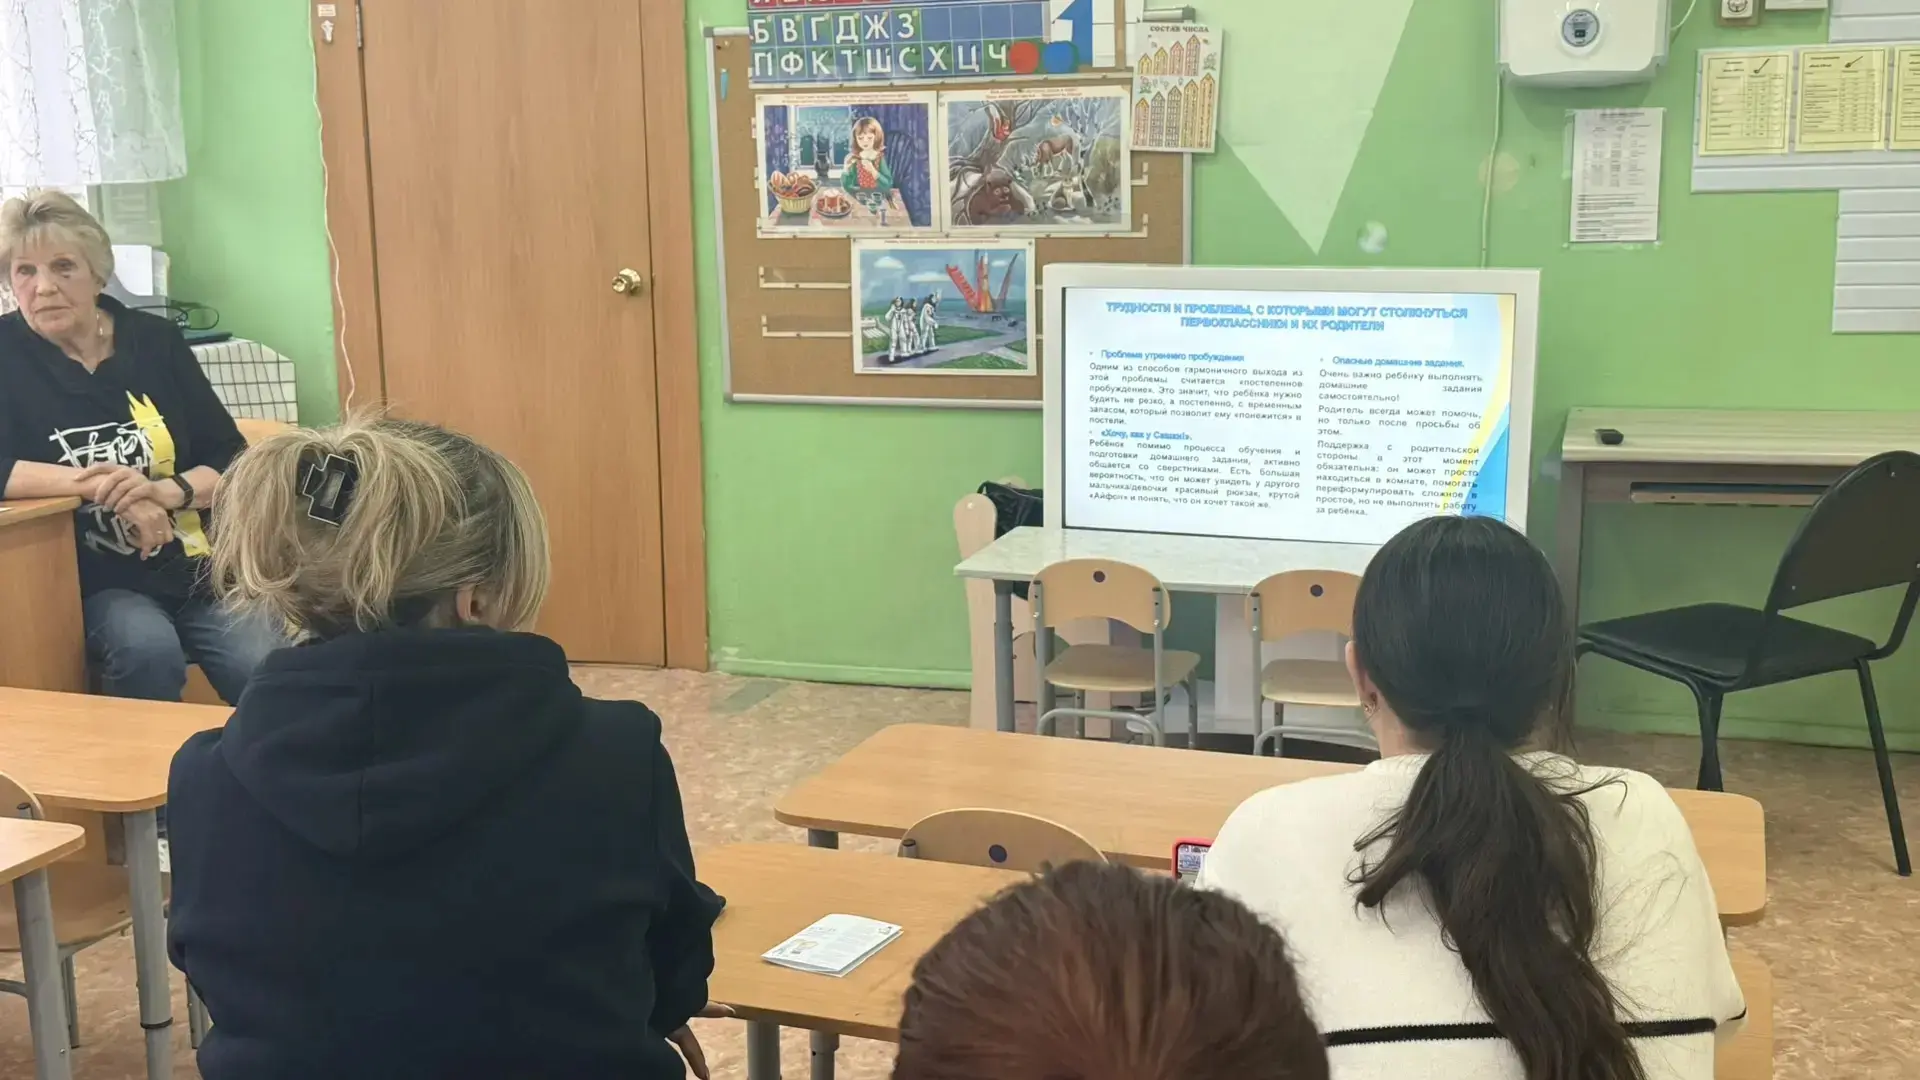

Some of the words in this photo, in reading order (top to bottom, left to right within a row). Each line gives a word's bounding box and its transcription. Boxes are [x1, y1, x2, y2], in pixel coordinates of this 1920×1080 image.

[754, 19, 770, 43] Б
[782, 18, 798, 42] В
[810, 17, 825, 41] Г
[836, 16, 859, 44] Д
[865, 15, 889, 39] Ж
[898, 13, 914, 38] З
[754, 52, 773, 76] П
[781, 52, 803, 75] Ф
[812, 51, 830, 74] К
[841, 50, 857, 74] Т
[867, 48, 891, 73] Ш
[899, 47, 916, 72] С
[928, 46, 947, 71] Х
[958, 45, 979, 72] Ц
[989, 44, 1006, 68] Ч
[1106, 302, 1171, 314] ТРУДНОСТИ
[1174, 304, 1181, 313] И
[1184, 303, 1253, 315] ПРОБЛЕМЫ,
[1256, 305, 1264, 314] С
[1268, 305, 1334, 316] КОТОРЫМИ
[1337, 306, 1377, 317] МОГУТ
[1380, 307, 1467, 318] СТОЛКНУТЬСЯ
[1181, 317, 1287, 329] ПЕРВОКЛАССНИКИ
[1291, 320, 1298, 329] И
[1303, 320, 1318, 329] ИХ
[1321, 320, 1384, 331] РОДИТЕЛИ
[1089, 363, 1118, 371] Одним
[1185, 367, 1247, 375] гармоничного
[1122, 376, 1167, 384] проблемы
[1179, 388, 1209, 396] значит,
[1319, 394, 1400, 402] самостоятельно!
[1089, 395, 1119, 403] будить
[1139, 398, 1165, 406] резко,
[1179, 399, 1233, 408] постепенно,
[1248, 401, 1301, 410] временным
[1089, 406, 1127, 415] запасом,
[1130, 408, 1167, 416] который
[1234, 411, 1292, 420] «понежится»
[1318, 406, 1363, 414] Родитель
[1468, 421, 1480, 429] об
[1184, 444, 1225, 452] процесса
[1239, 446, 1281, 455] обучения
[1317, 440, 1368, 450] Поддержка
[1411, 445, 1479, 454] родительской
[1089, 451, 1138, 460] подготовки
[1150, 453, 1199, 462] домашнего
[1212, 456, 1250, 465] задания,
[1089, 461, 1130, 470] общается
[1157, 465, 1220, 474] сверстниками.
[1260, 468, 1300, 477] большая
[1317, 464, 1379, 472] обязательна:
[1089, 473, 1146, 481] вероятность,
[1215, 478, 1251, 486] увидеть
[1089, 482, 1168, 492] мальчика/девочки
[1175, 486, 1218, 495] красивый
[1226, 489, 1260, 498] рюкзак,
[1269, 491, 1299, 499] крутой
[1316, 485, 1414, 496] переформулировать
[1089, 493, 1128, 501] «Айфон»
[1138, 495, 1170, 504] понять,
[1443, 502, 1476, 511] работу
